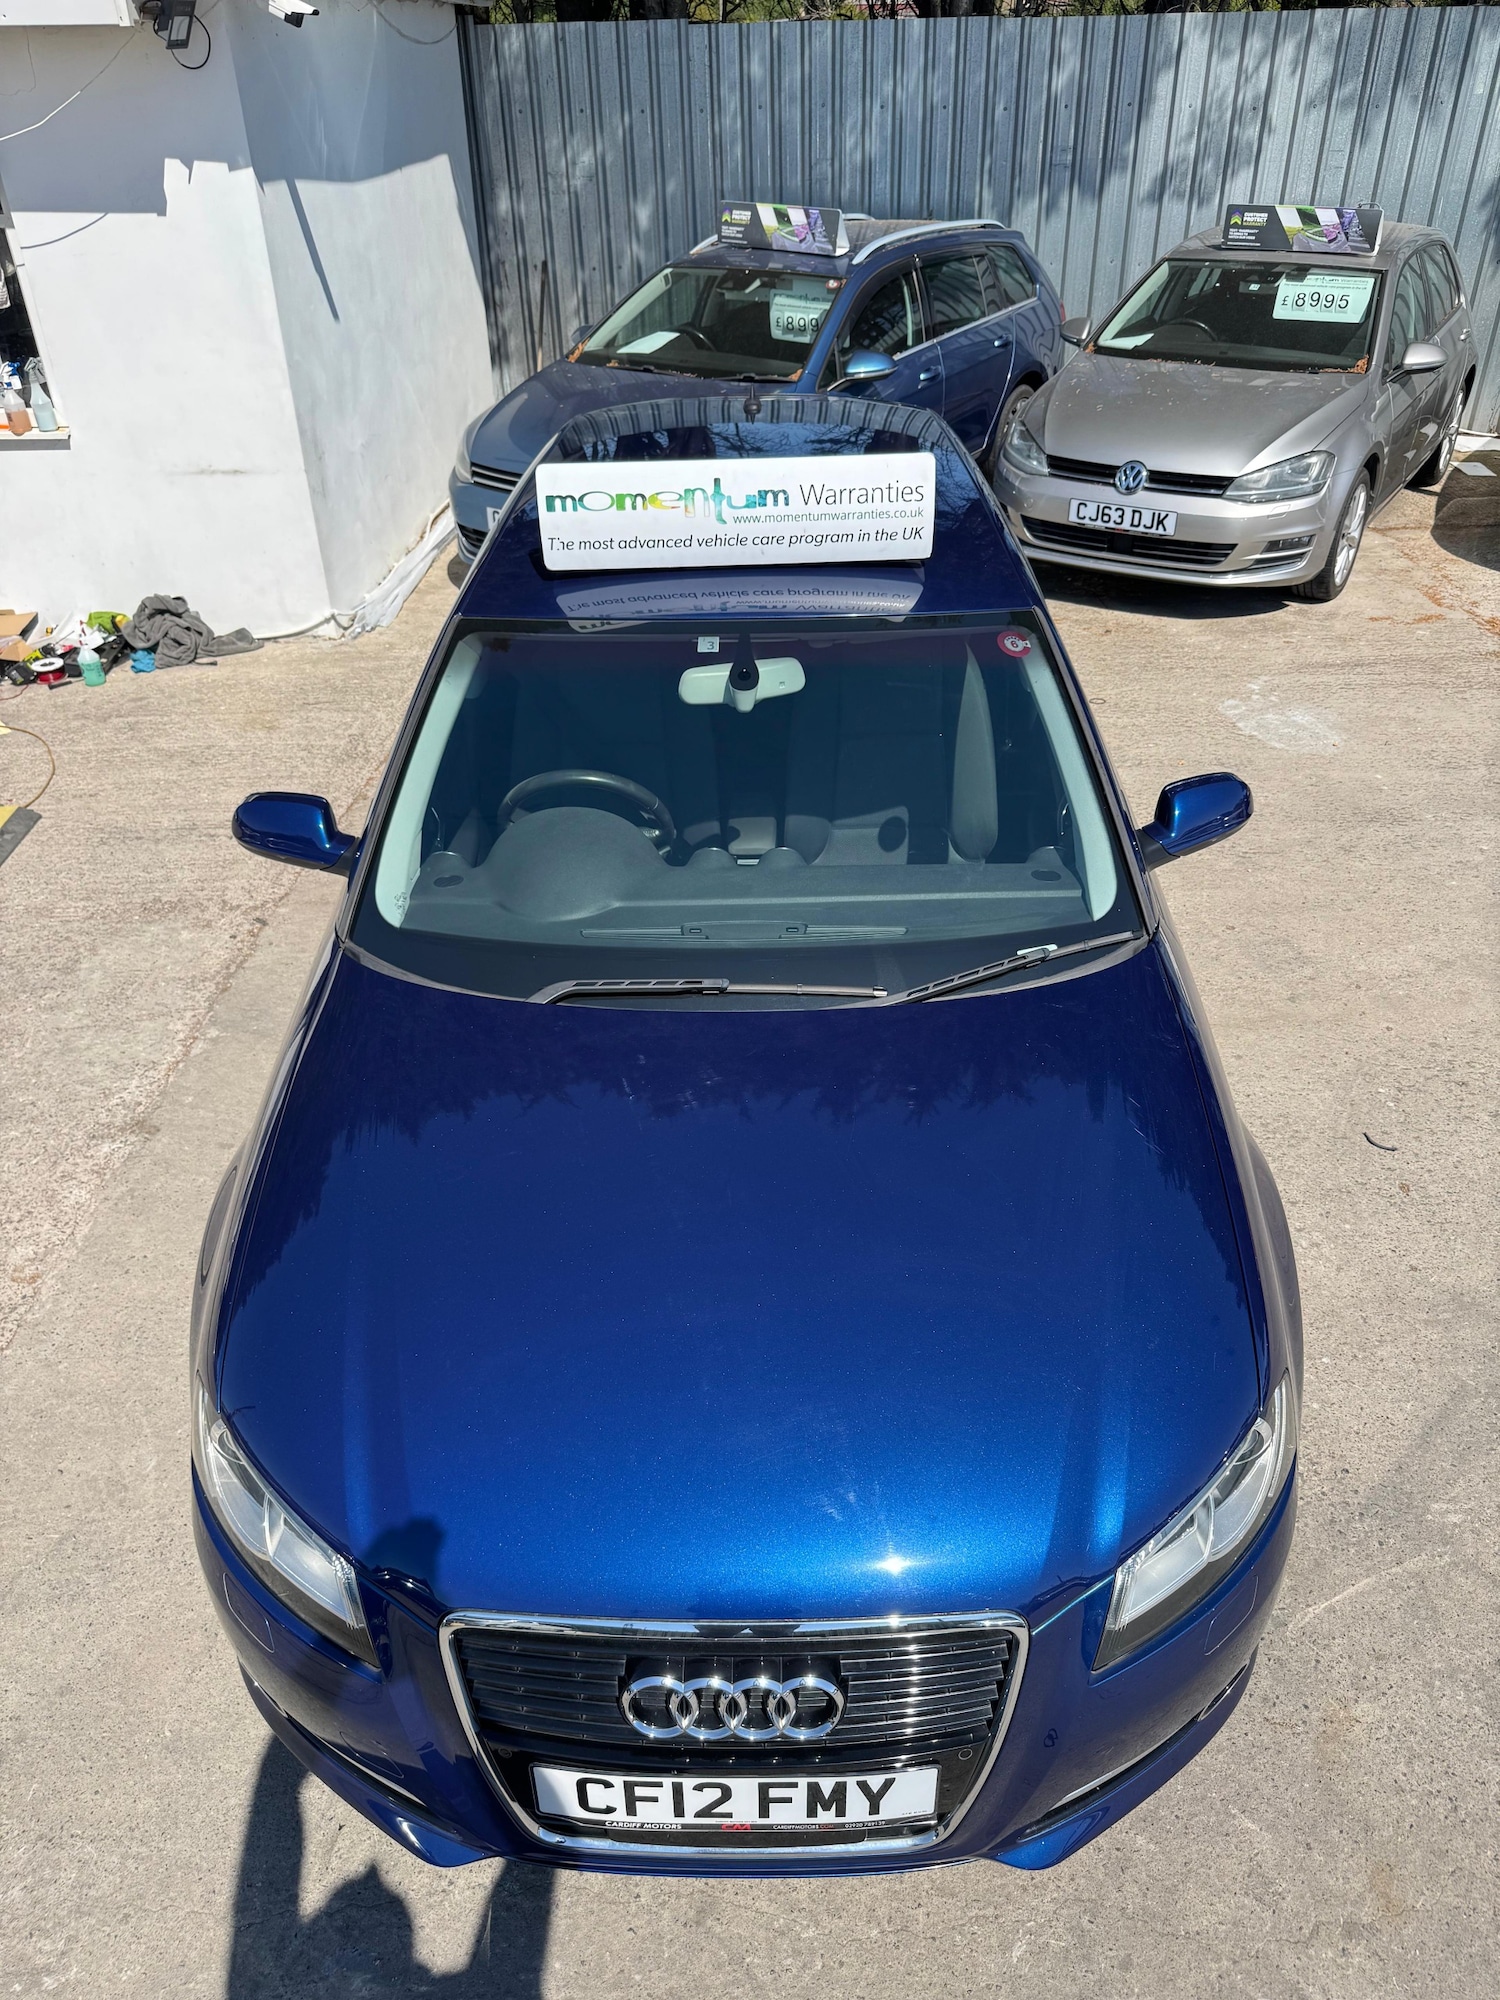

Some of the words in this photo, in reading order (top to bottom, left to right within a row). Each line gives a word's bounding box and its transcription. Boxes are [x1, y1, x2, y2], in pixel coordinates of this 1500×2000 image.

[545, 477, 790, 525] momentum
[799, 480, 925, 506] Warranties
[732, 506, 925, 525] www.momentumwarranties.co.uk
[1076, 502, 1125, 526] CJ63
[1130, 509, 1169, 532] DJK
[578, 538, 615, 551] most
[618, 534, 693, 549] advanced
[697, 533, 748, 547] vehicle
[752, 534, 785, 546] care
[788, 530, 854, 548] program
[858, 529, 871, 543] in
[875, 528, 898, 542] the
[902, 526, 925, 541] UK
[706, 641, 715, 650] 3
[575, 1777, 734, 1819] CF12
[757, 1777, 897, 1819] FMY
[604, 1820, 641, 1829] CARDIFF
[643, 1822, 682, 1830] MOTORS
